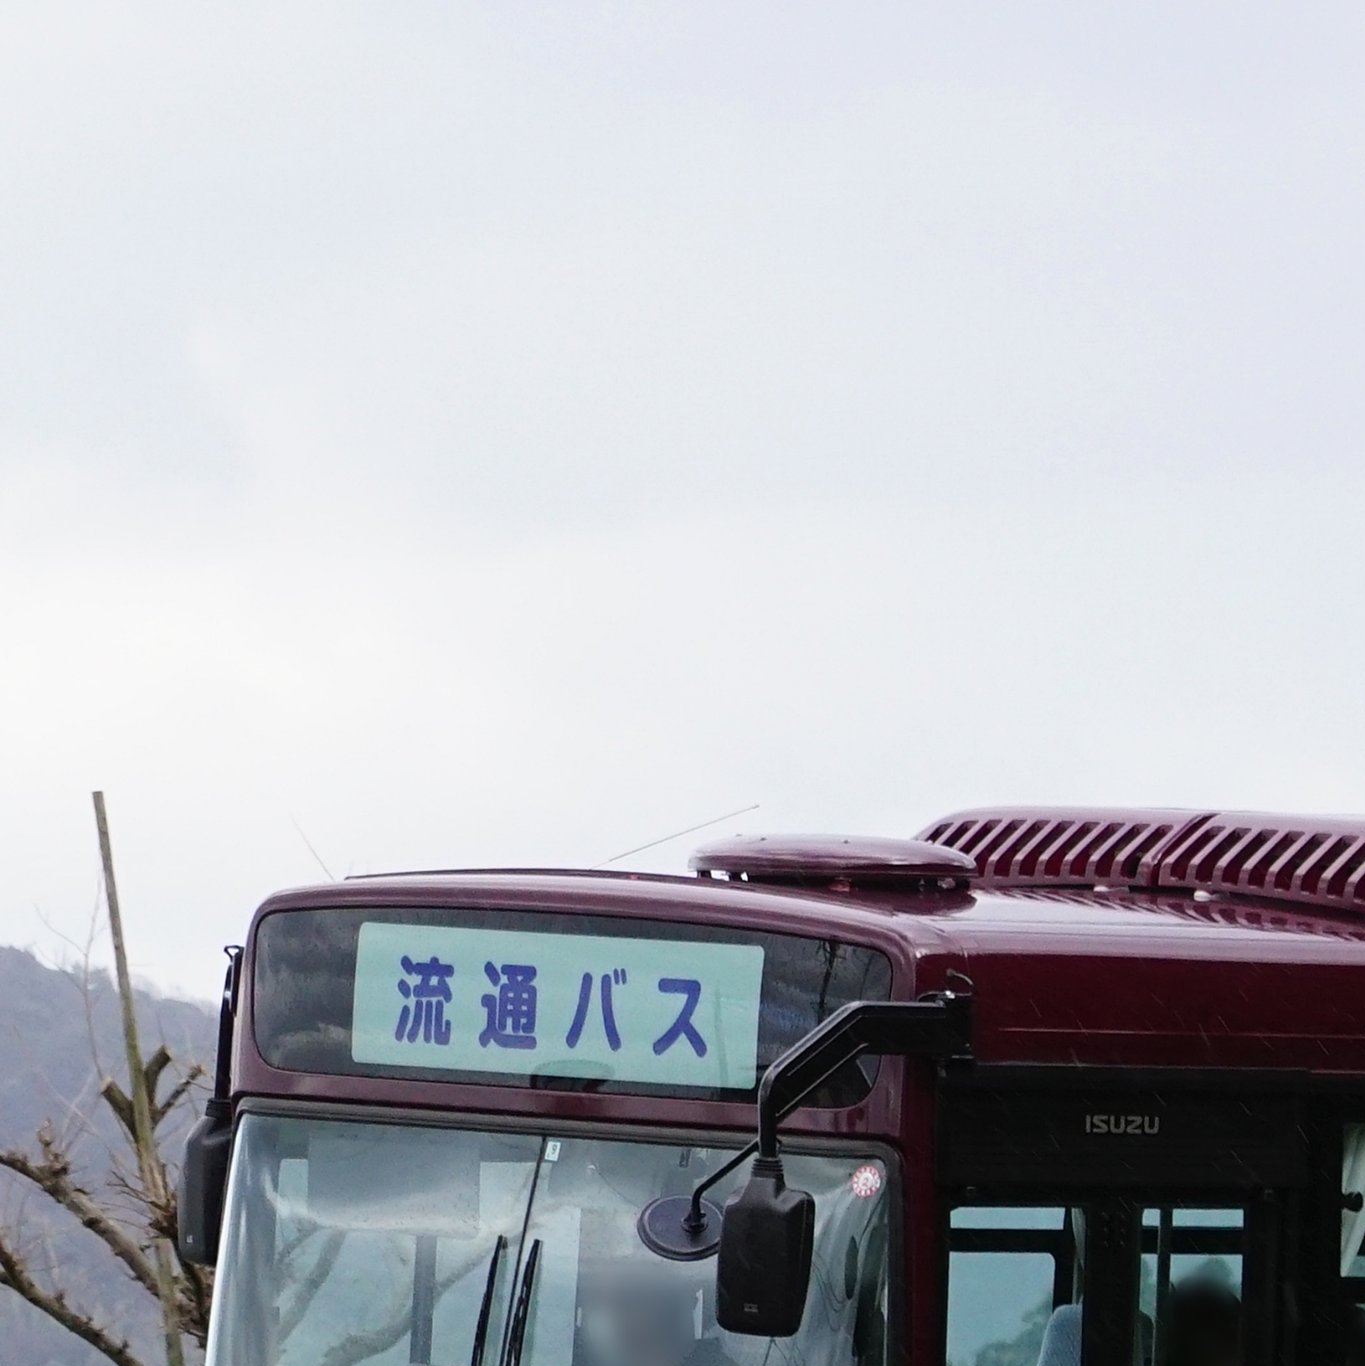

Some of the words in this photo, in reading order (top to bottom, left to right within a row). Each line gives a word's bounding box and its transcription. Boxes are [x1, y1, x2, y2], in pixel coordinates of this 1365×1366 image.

[395, 954, 708, 1058] 流通バス
[1085, 1114, 1160, 1135] ISUZU
